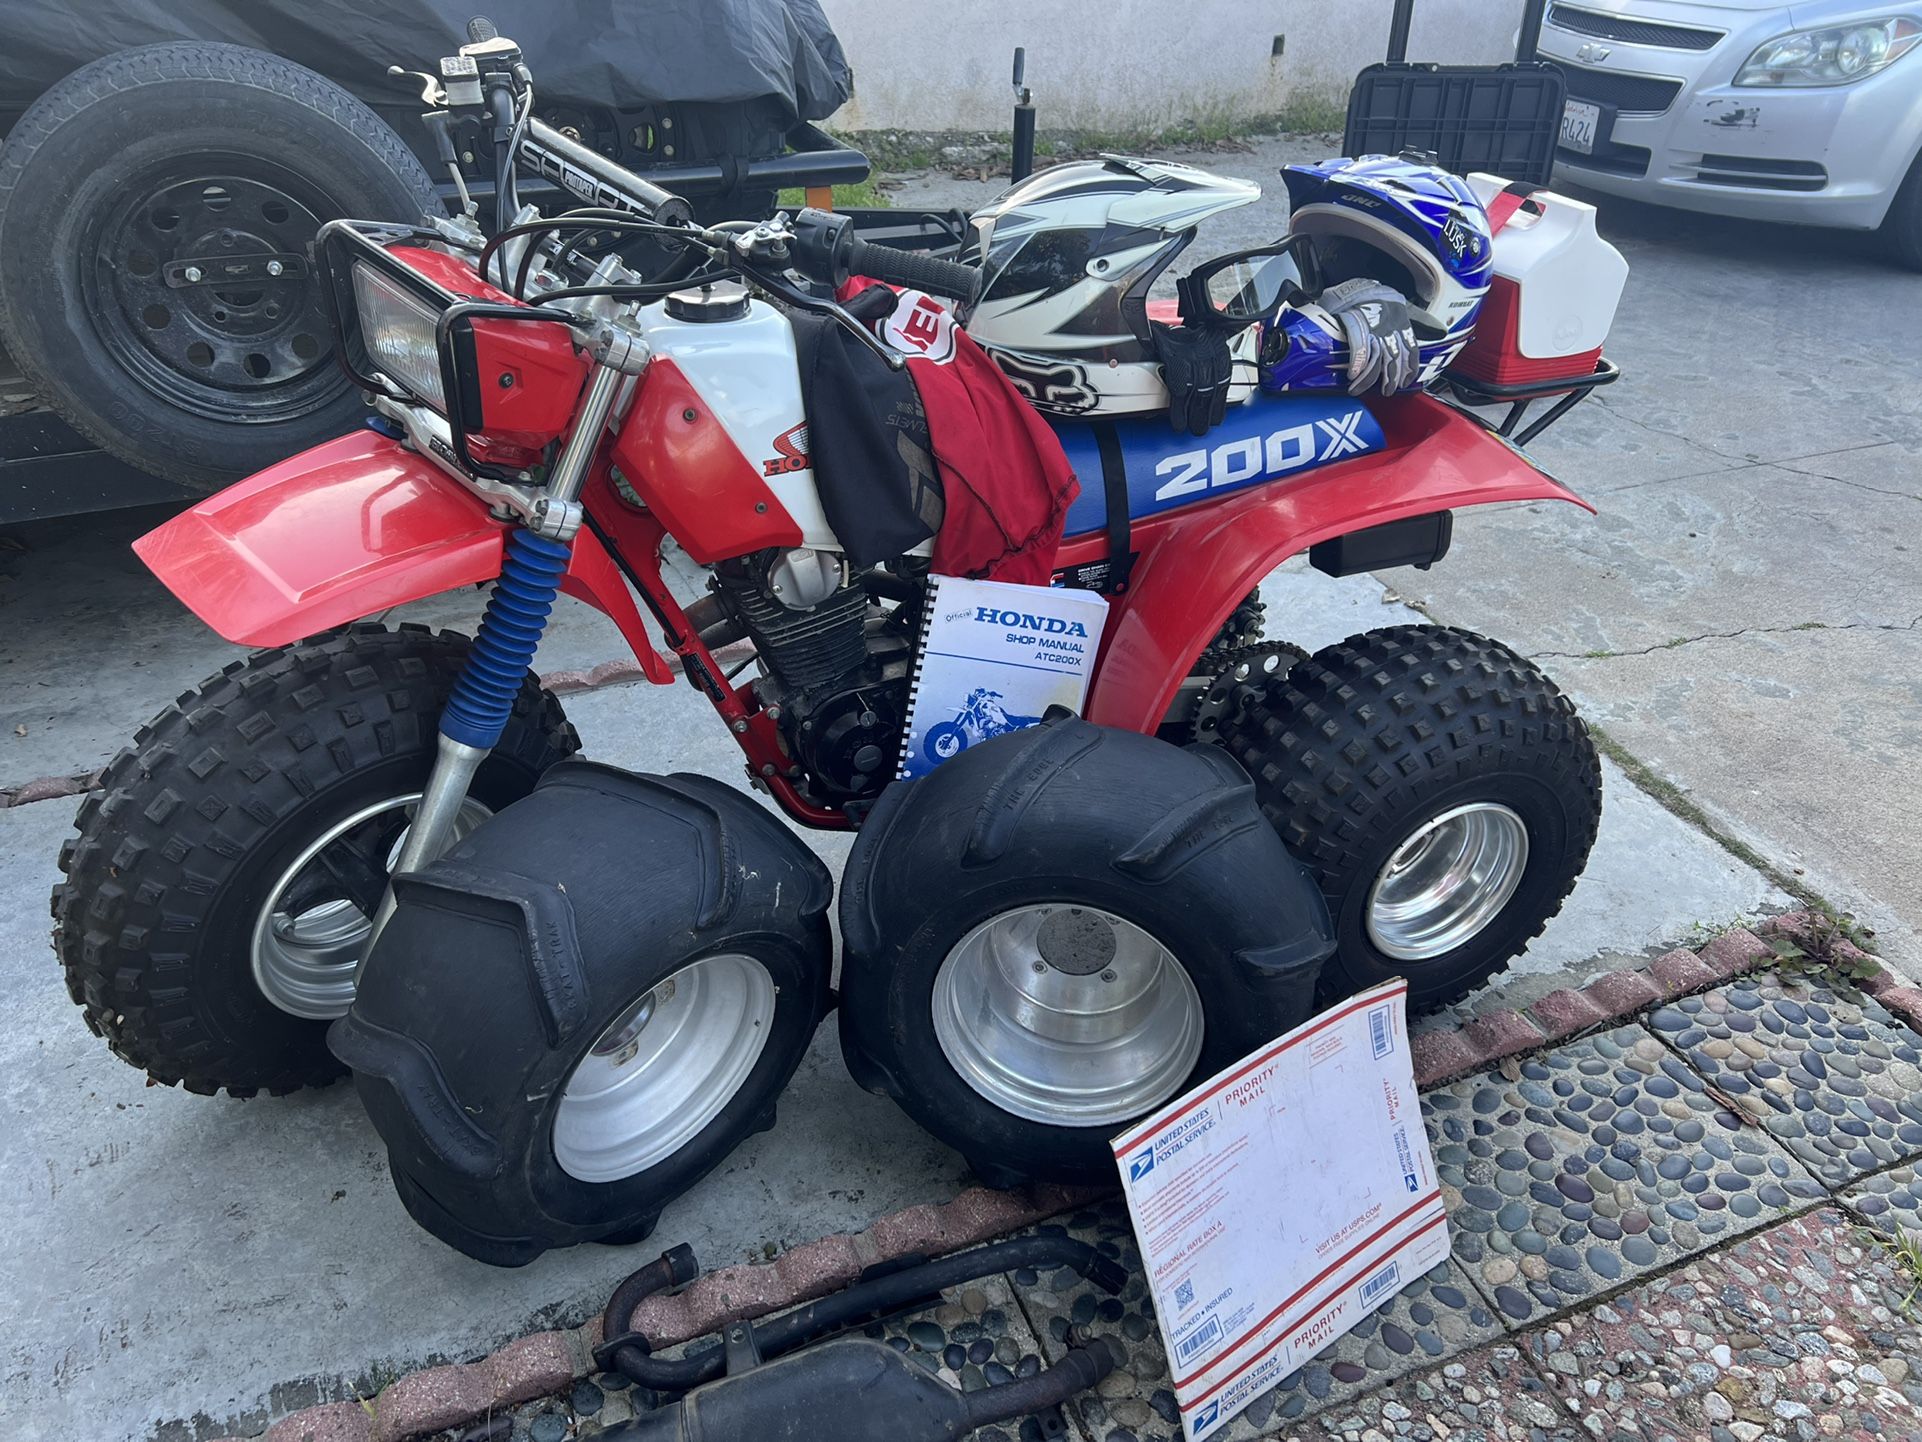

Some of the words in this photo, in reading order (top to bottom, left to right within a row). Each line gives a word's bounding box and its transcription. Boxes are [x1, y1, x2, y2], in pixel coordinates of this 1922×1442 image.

[564, 170, 594, 198] PROTAPER
[1154, 410, 1369, 502] 200X
[945, 610, 973, 622] Official
[974, 606, 1089, 638] HONDA
[1005, 632, 1036, 646] SHOP
[1038, 638, 1085, 654] MANUAL
[1034, 652, 1082, 667] ATC200X
[1225, 1066, 1275, 1105] PRIORITY
[1239, 1086, 1266, 1108] MAIL
[1383, 1080, 1396, 1121] PRIORITY
[1391, 1087, 1399, 1108] MAIL
[1154, 1125, 1184, 1151] UNITED
[1184, 1107, 1210, 1131] STATES
[1156, 1142, 1185, 1166] POSTAL
[1154, 1250, 1186, 1278] REGIONAL
[1186, 1234, 1203, 1252] RATE
[1203, 1225, 1217, 1239] BOX
[1315, 1240, 1331, 1254] VISIT
[1331, 1232, 1341, 1243] US
[1340, 1226, 1349, 1237] AT
[1171, 1312, 1201, 1340] TRACKED
[1204, 1287, 1233, 1313] INSURED
[1294, 1303, 1343, 1349] PRIORITY
[1308, 1326, 1335, 1350] MAIL
[1220, 1376, 1251, 1403] UNITED
[1251, 1356, 1278, 1381] STATES
[1219, 1390, 1250, 1416] POSTAL
